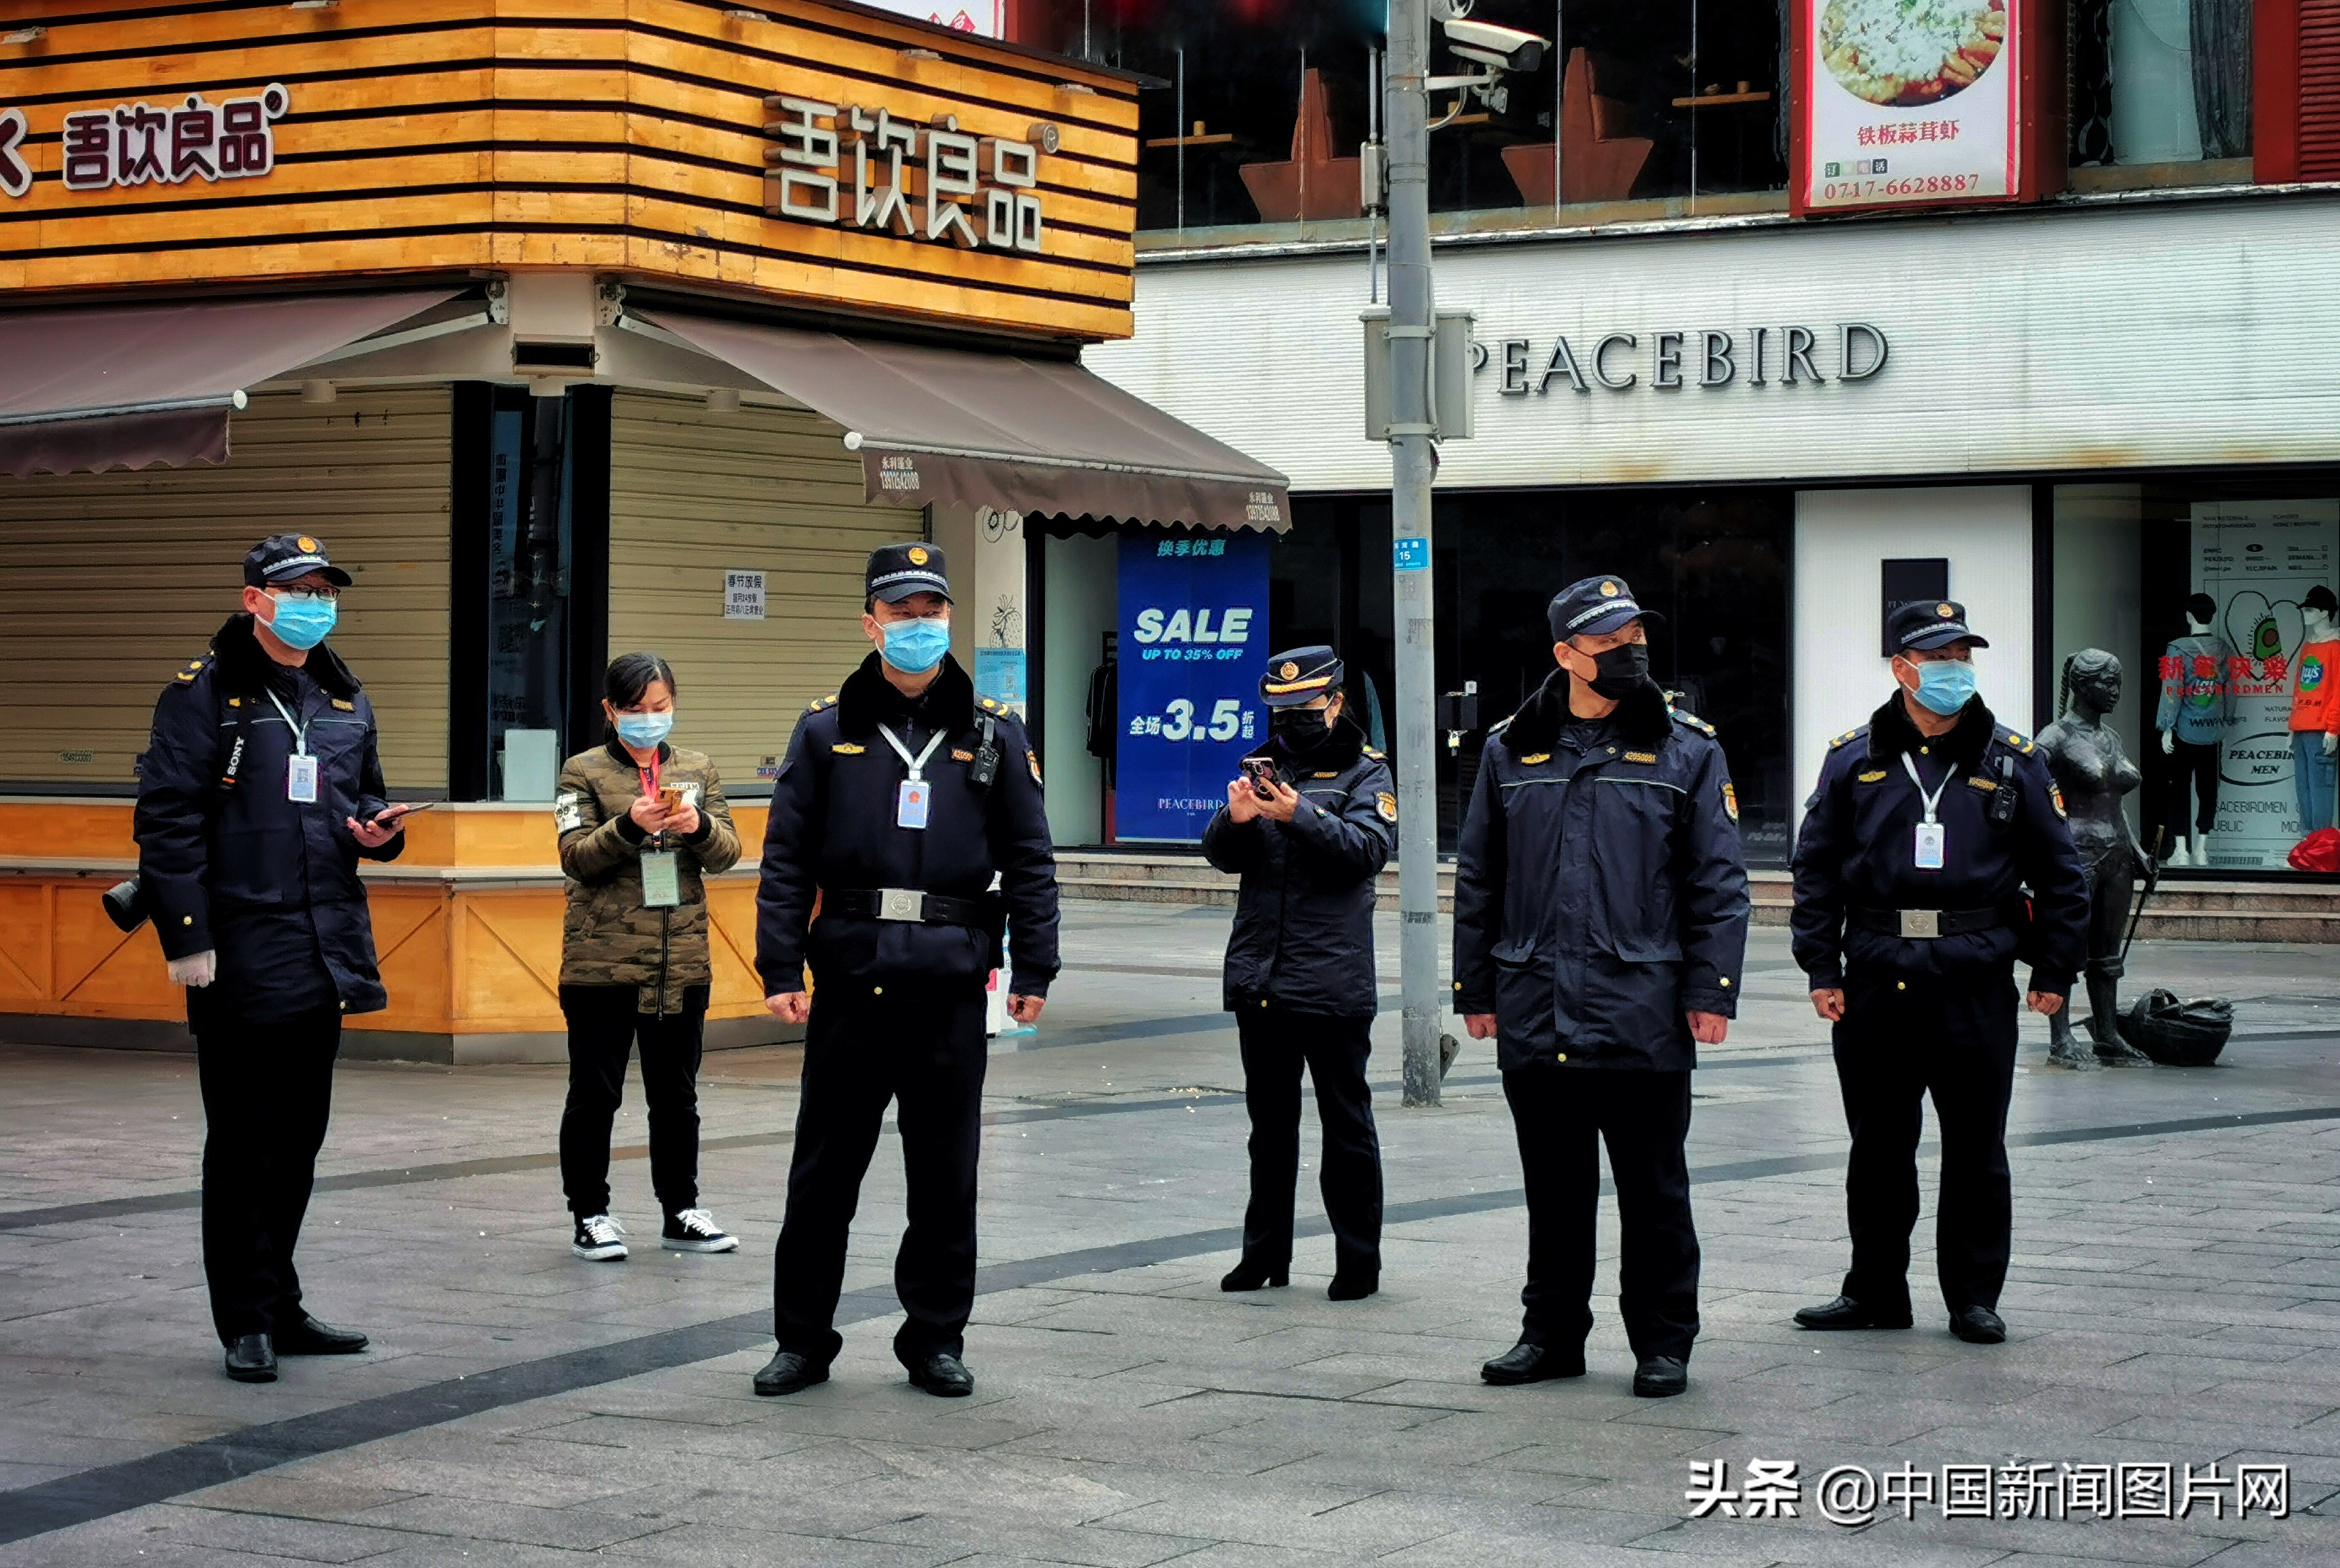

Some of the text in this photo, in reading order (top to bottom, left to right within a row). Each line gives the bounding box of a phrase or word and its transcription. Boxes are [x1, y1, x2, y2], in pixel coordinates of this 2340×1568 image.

[65, 96, 268, 184] 吾饮良品
[1856, 119, 1960, 146] 铁板蒜茸虾
[764, 96, 1042, 253] 吾饮良品
[1824, 173, 1979, 200] 0717-6628887
[1157, 539, 1227, 557] 换季优惠
[1399, 551, 1411, 561] 15
[1133, 608, 1253, 643] SALE
[1142, 649, 1243, 660] UP TO 35% OFF
[1130, 698, 1255, 740] 全场 3.5 折起
[227, 736, 245, 776] SONY
[2251, 765, 2280, 774] MEN
[1158, 798, 1224, 810] PEACEBIRD
